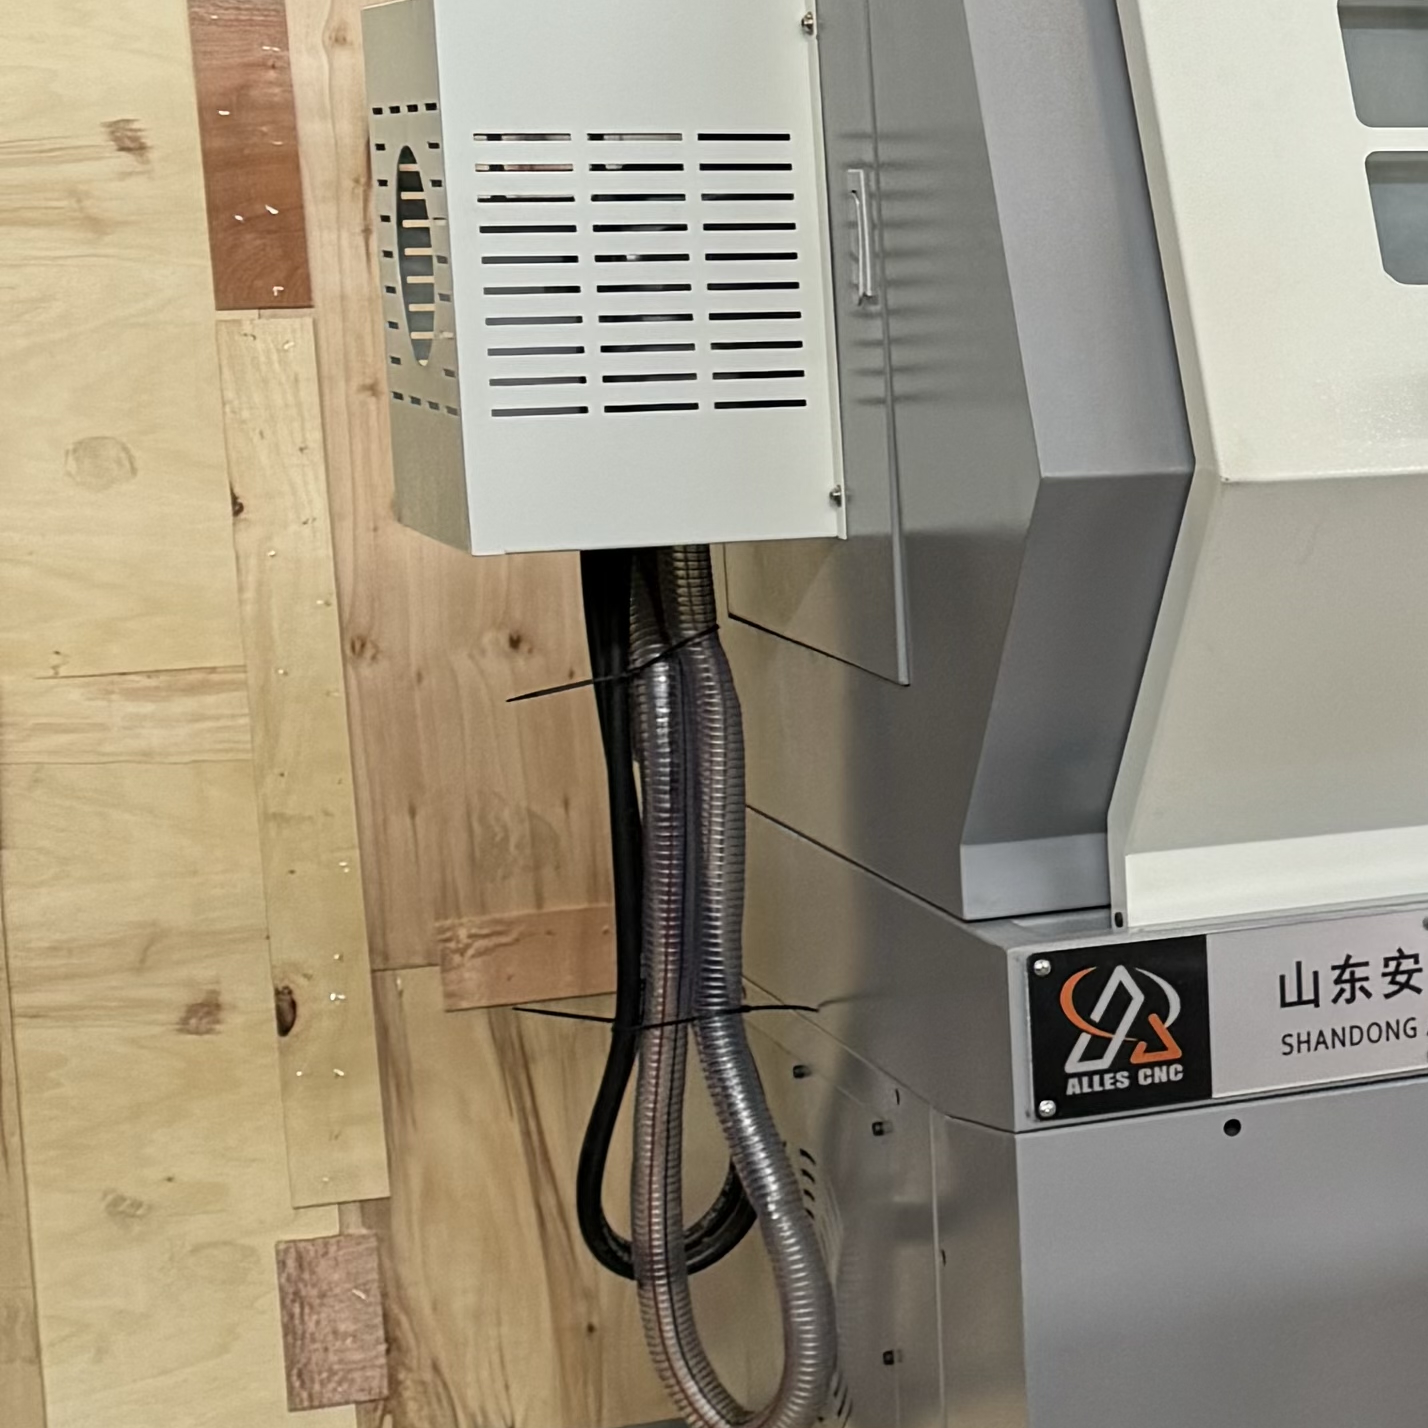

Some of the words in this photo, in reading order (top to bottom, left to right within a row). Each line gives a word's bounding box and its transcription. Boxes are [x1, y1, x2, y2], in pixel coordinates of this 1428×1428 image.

[1281, 1016, 1418, 1057] SHANDONG
[1066, 1072, 1130, 1096] ALLES
[1138, 1063, 1184, 1087] CNC
